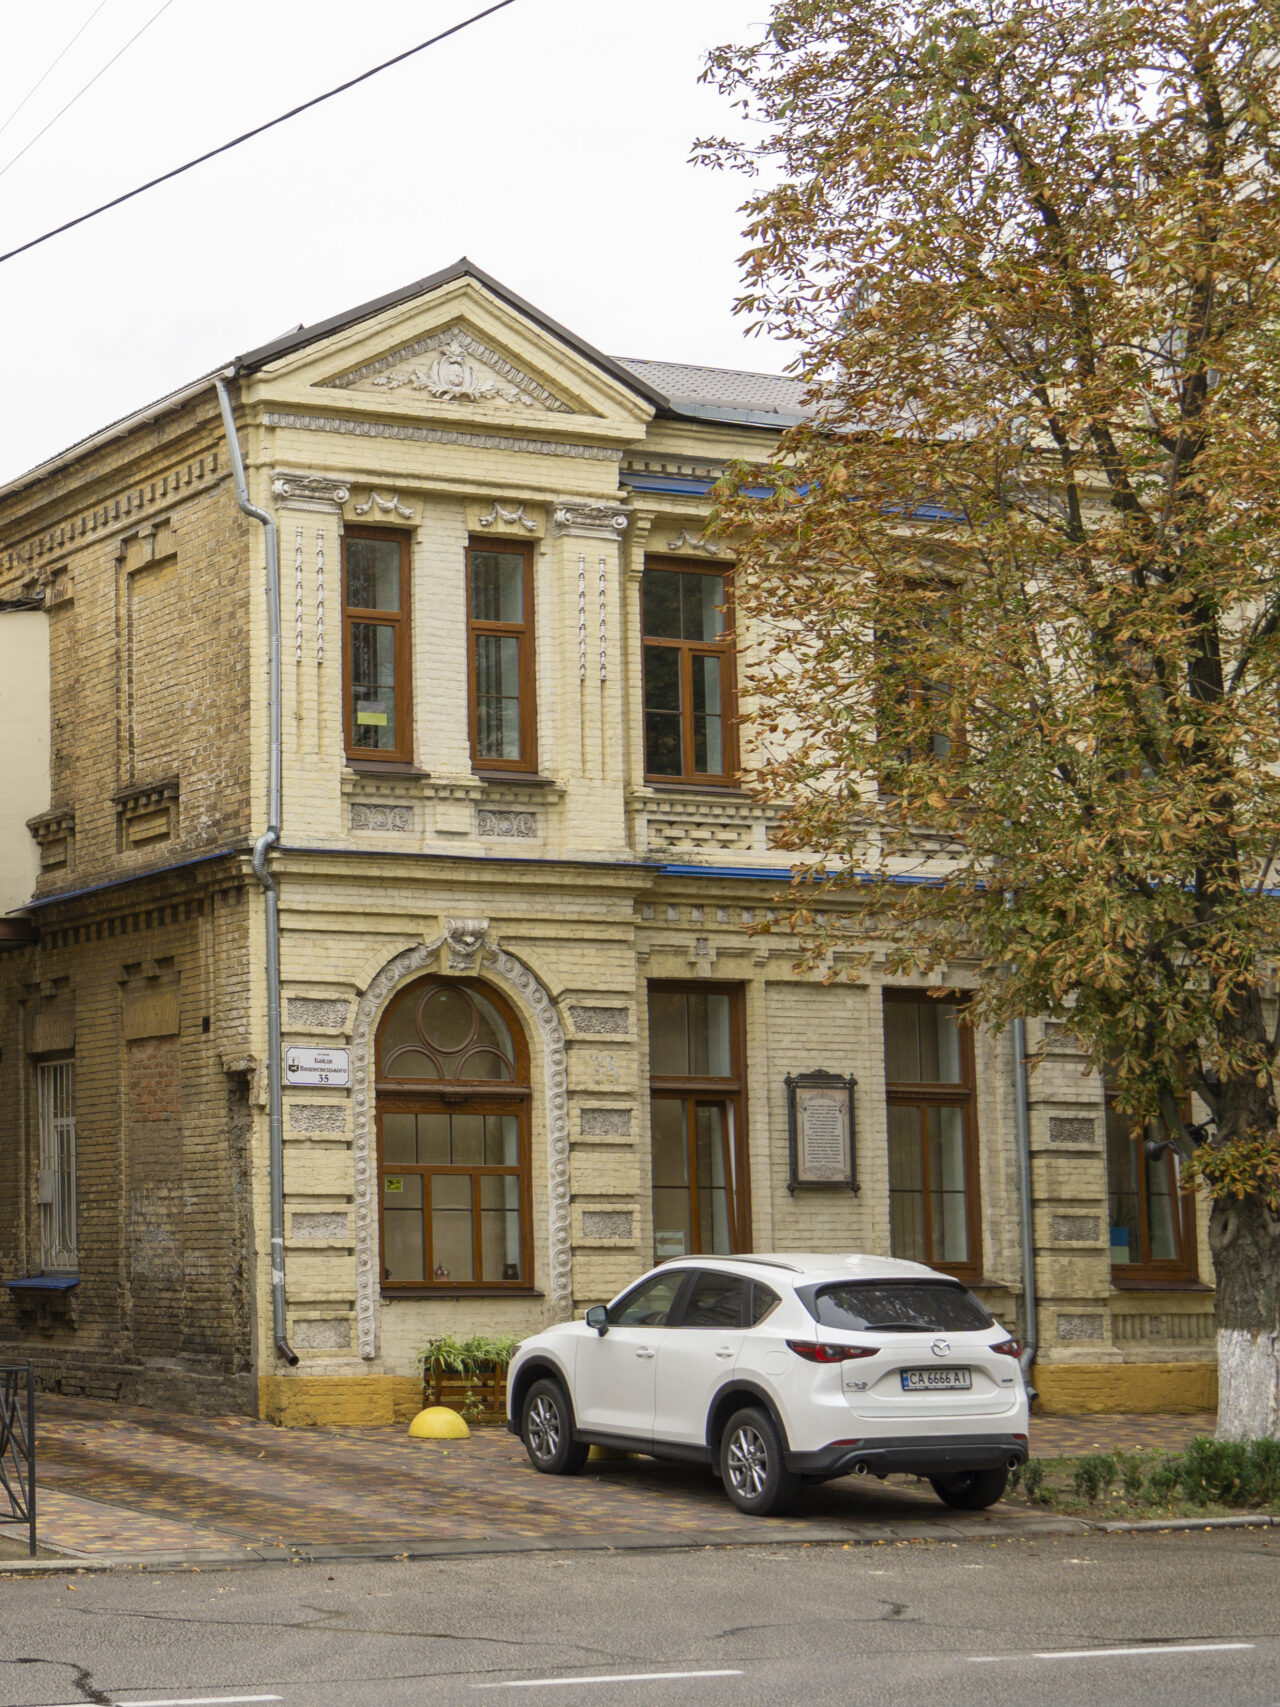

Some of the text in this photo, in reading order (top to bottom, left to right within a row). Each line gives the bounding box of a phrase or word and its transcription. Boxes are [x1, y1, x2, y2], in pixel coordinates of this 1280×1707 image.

[300, 1065, 347, 1073] Вишневецького
[318, 1074, 329, 1083] 35
[910, 1371, 966, 1385] CA 6666 AI
